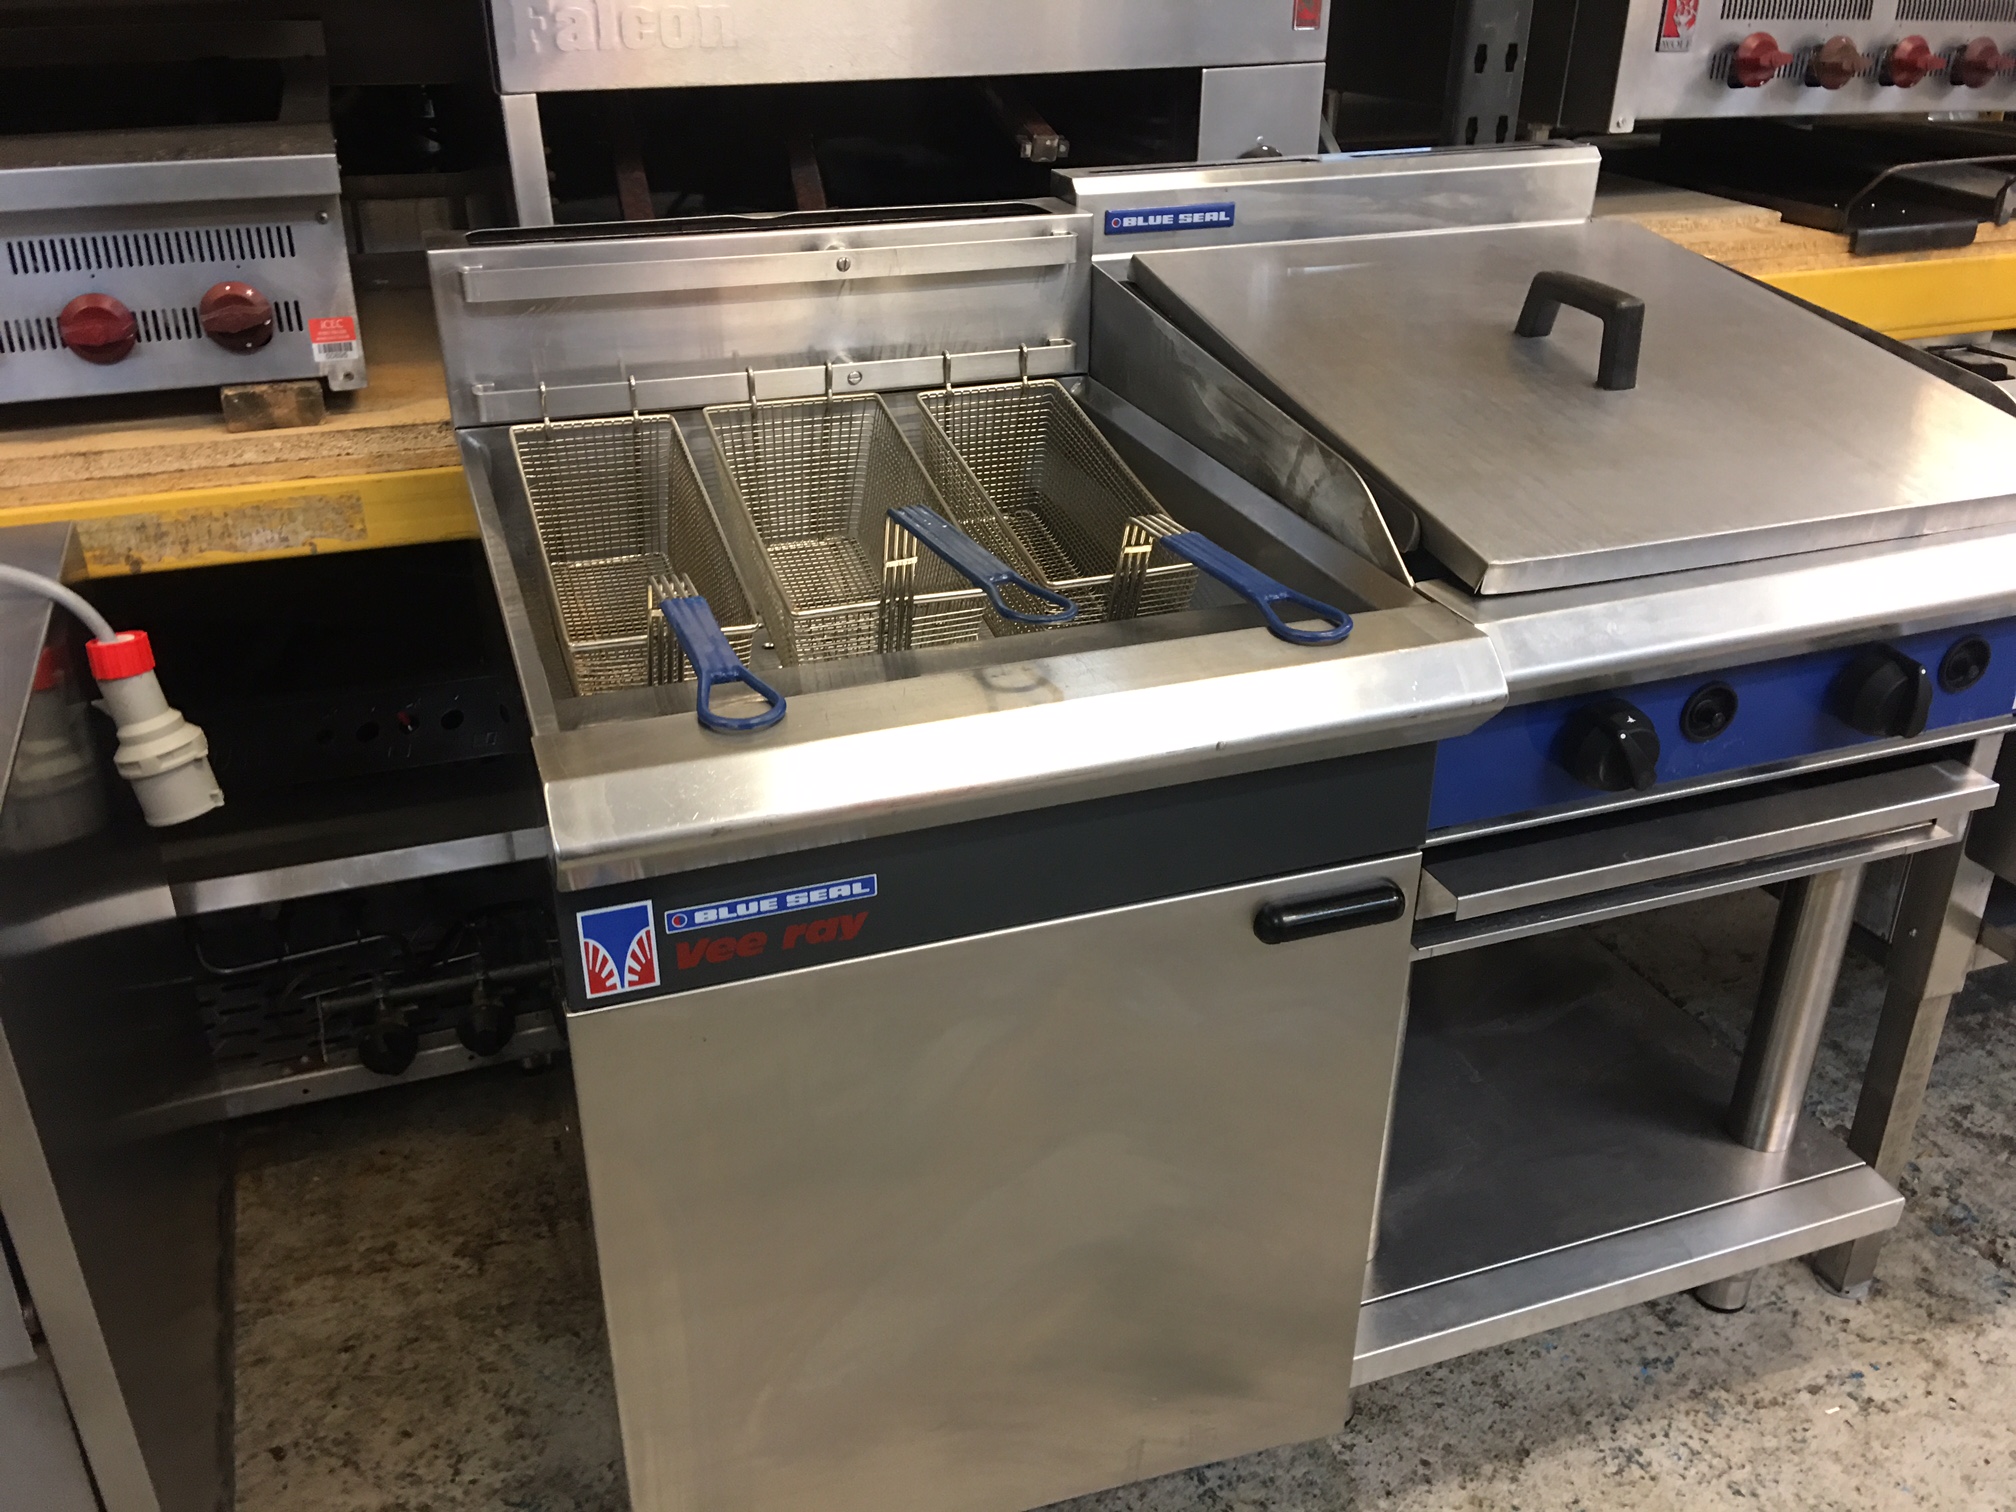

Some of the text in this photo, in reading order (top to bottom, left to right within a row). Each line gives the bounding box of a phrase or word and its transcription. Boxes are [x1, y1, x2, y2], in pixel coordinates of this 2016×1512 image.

[511, 0, 738, 54] Falcon
[1122, 211, 1230, 227] BLUE SEAL
[694, 882, 871, 925] BLUE SEAL
[782, 911, 869, 950] ray
